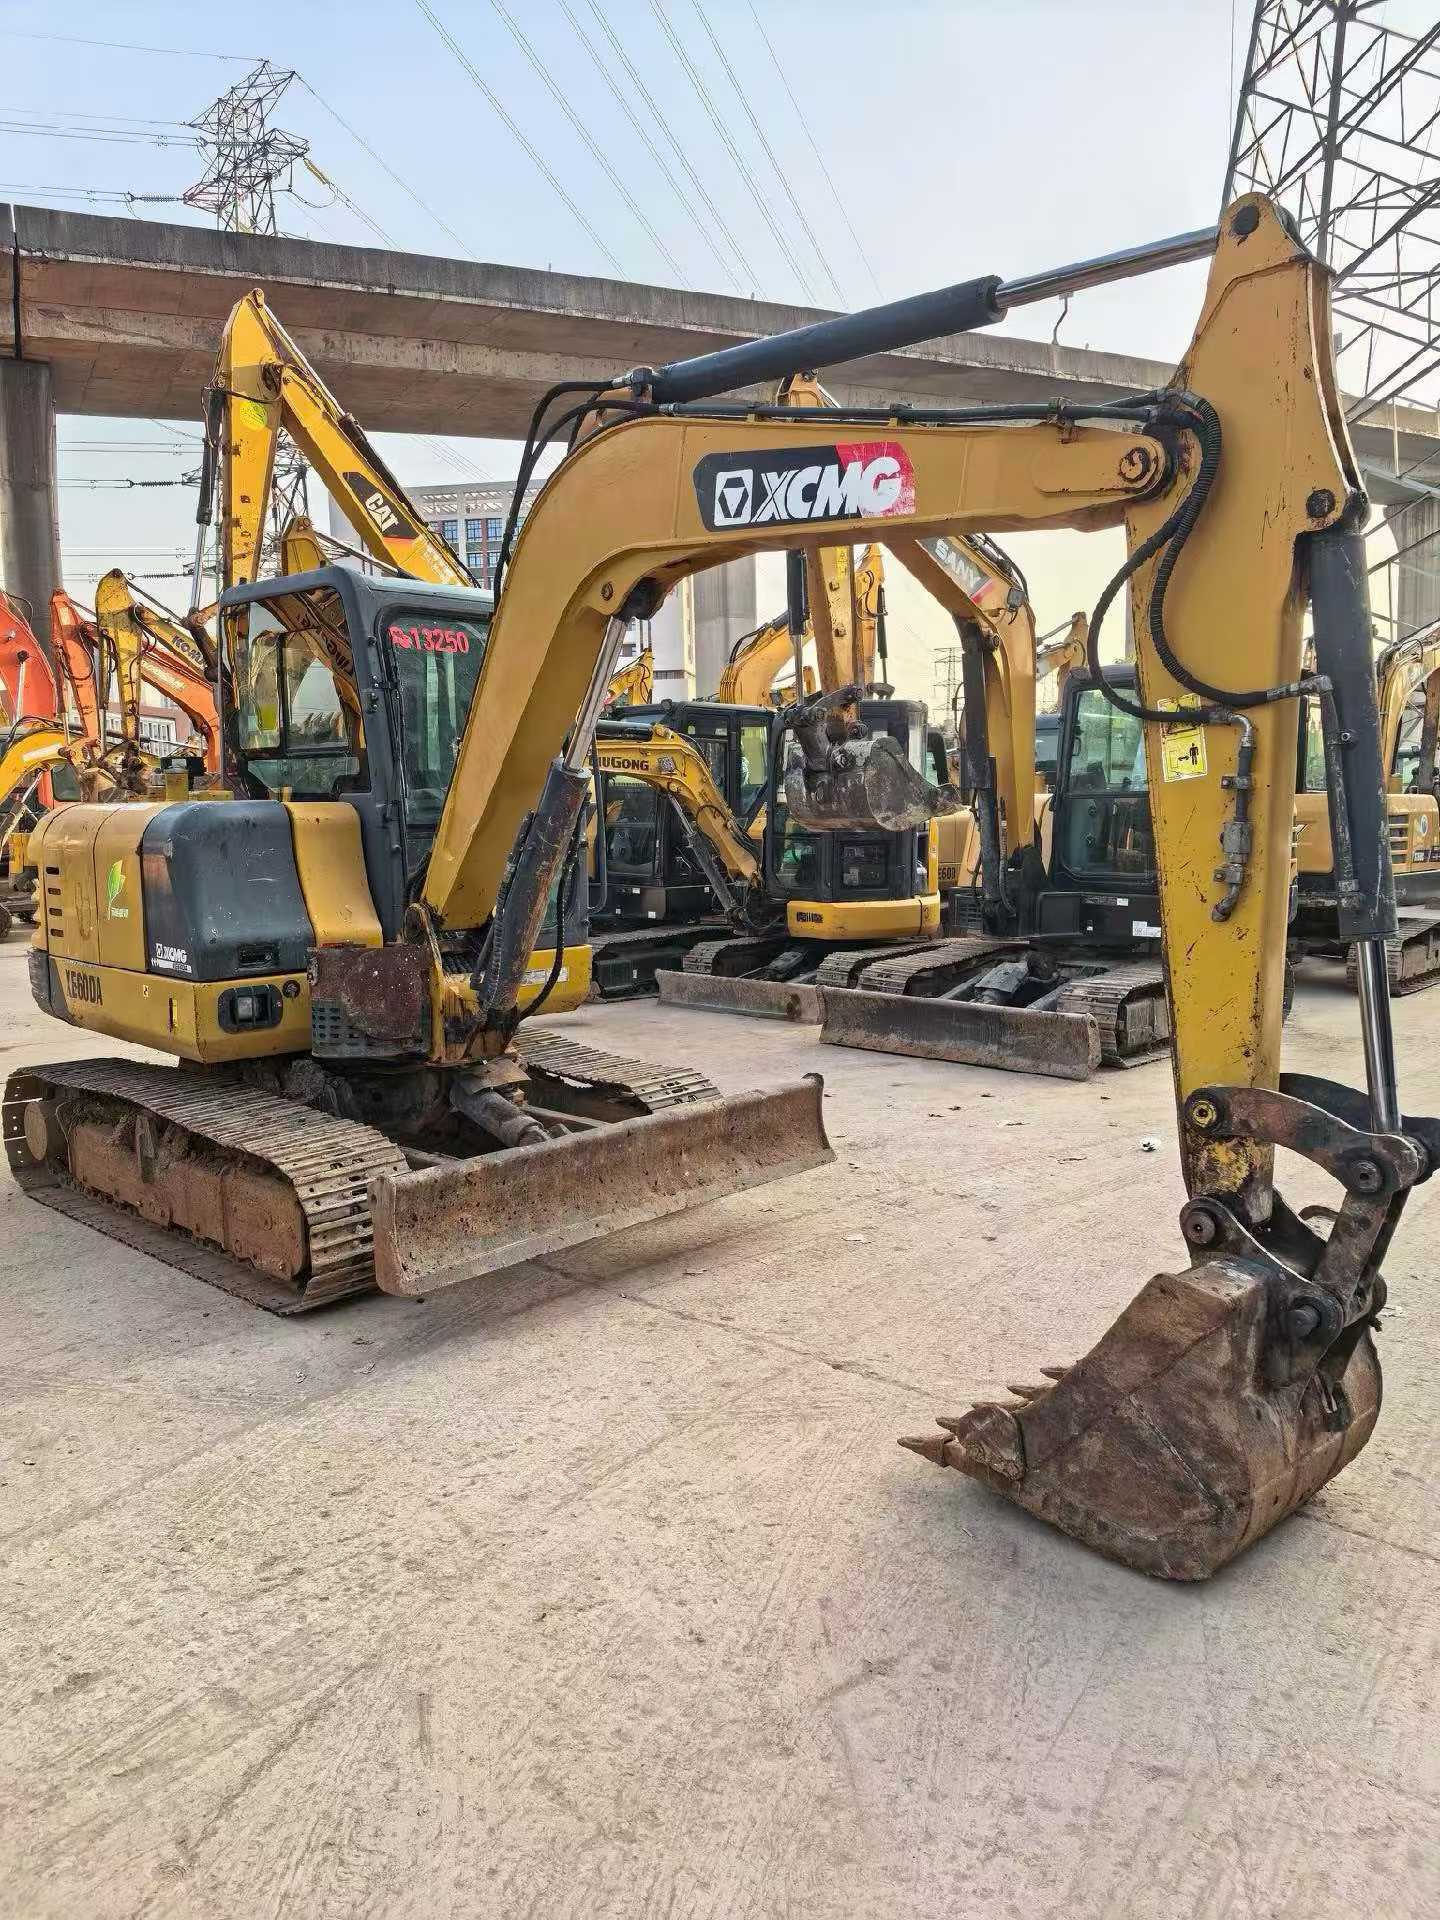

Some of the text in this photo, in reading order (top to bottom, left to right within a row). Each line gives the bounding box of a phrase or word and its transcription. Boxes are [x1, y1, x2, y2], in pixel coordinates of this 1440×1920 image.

[751, 456, 902, 523] XCMG
[365, 492, 400, 533] CAT
[65, 969, 103, 1006] XE60DA
